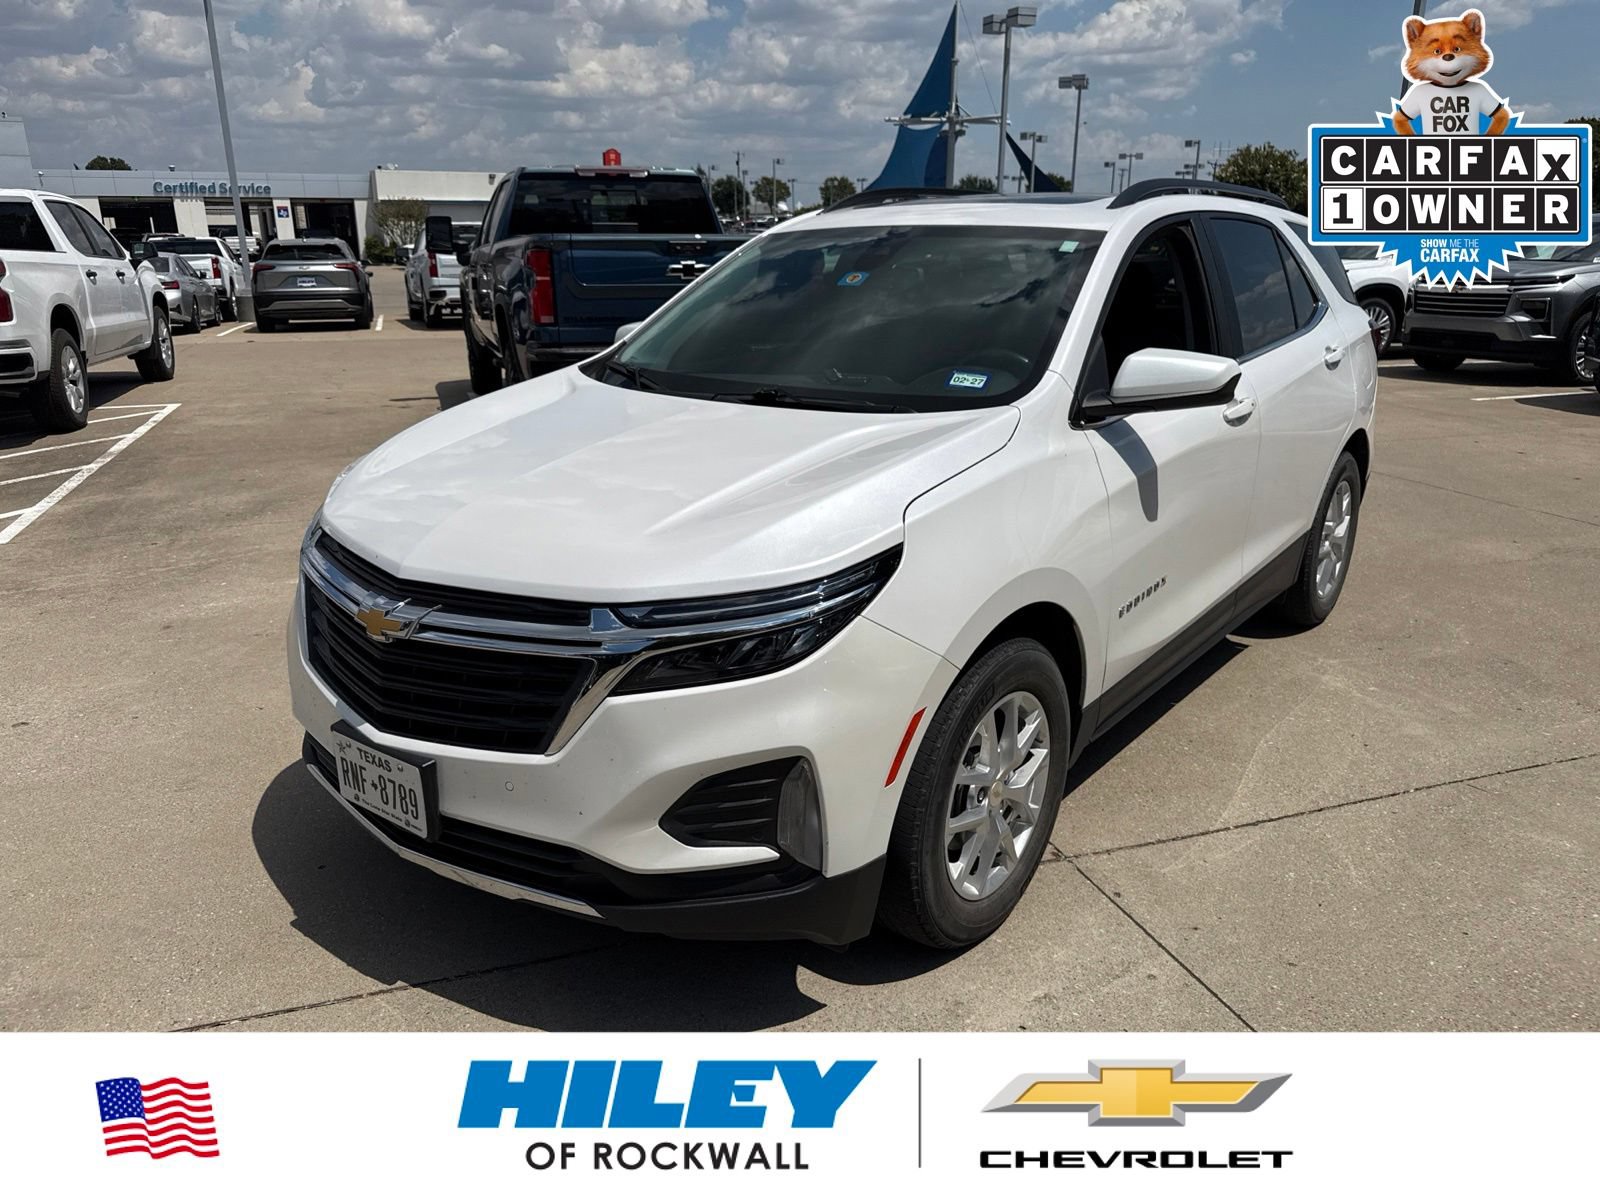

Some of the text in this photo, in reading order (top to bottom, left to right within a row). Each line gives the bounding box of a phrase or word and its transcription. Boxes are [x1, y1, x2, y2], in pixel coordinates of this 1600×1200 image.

[153, 181, 216, 194] Certified
[356, 746, 392, 773] TEXAS
[378, 774, 419, 821] 8789
